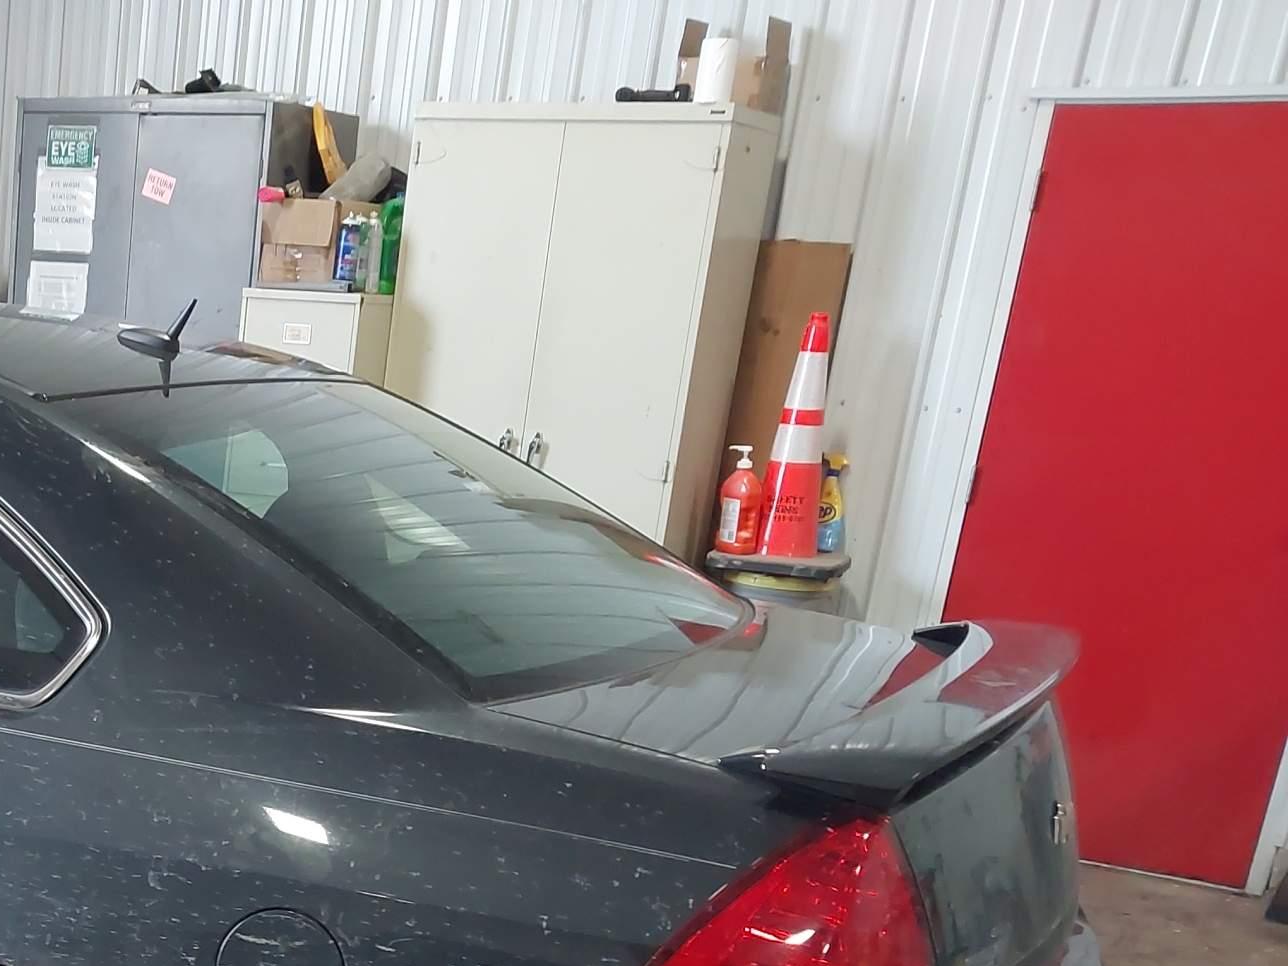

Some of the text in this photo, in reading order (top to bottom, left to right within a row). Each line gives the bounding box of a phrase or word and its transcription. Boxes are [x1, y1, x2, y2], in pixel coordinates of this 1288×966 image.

[51, 129, 93, 141] EMERGENCY
[52, 141, 76, 156] EYE
[52, 155, 75, 165] WASH
[148, 174, 173, 190] RETURN
[152, 184, 165, 197] TOW
